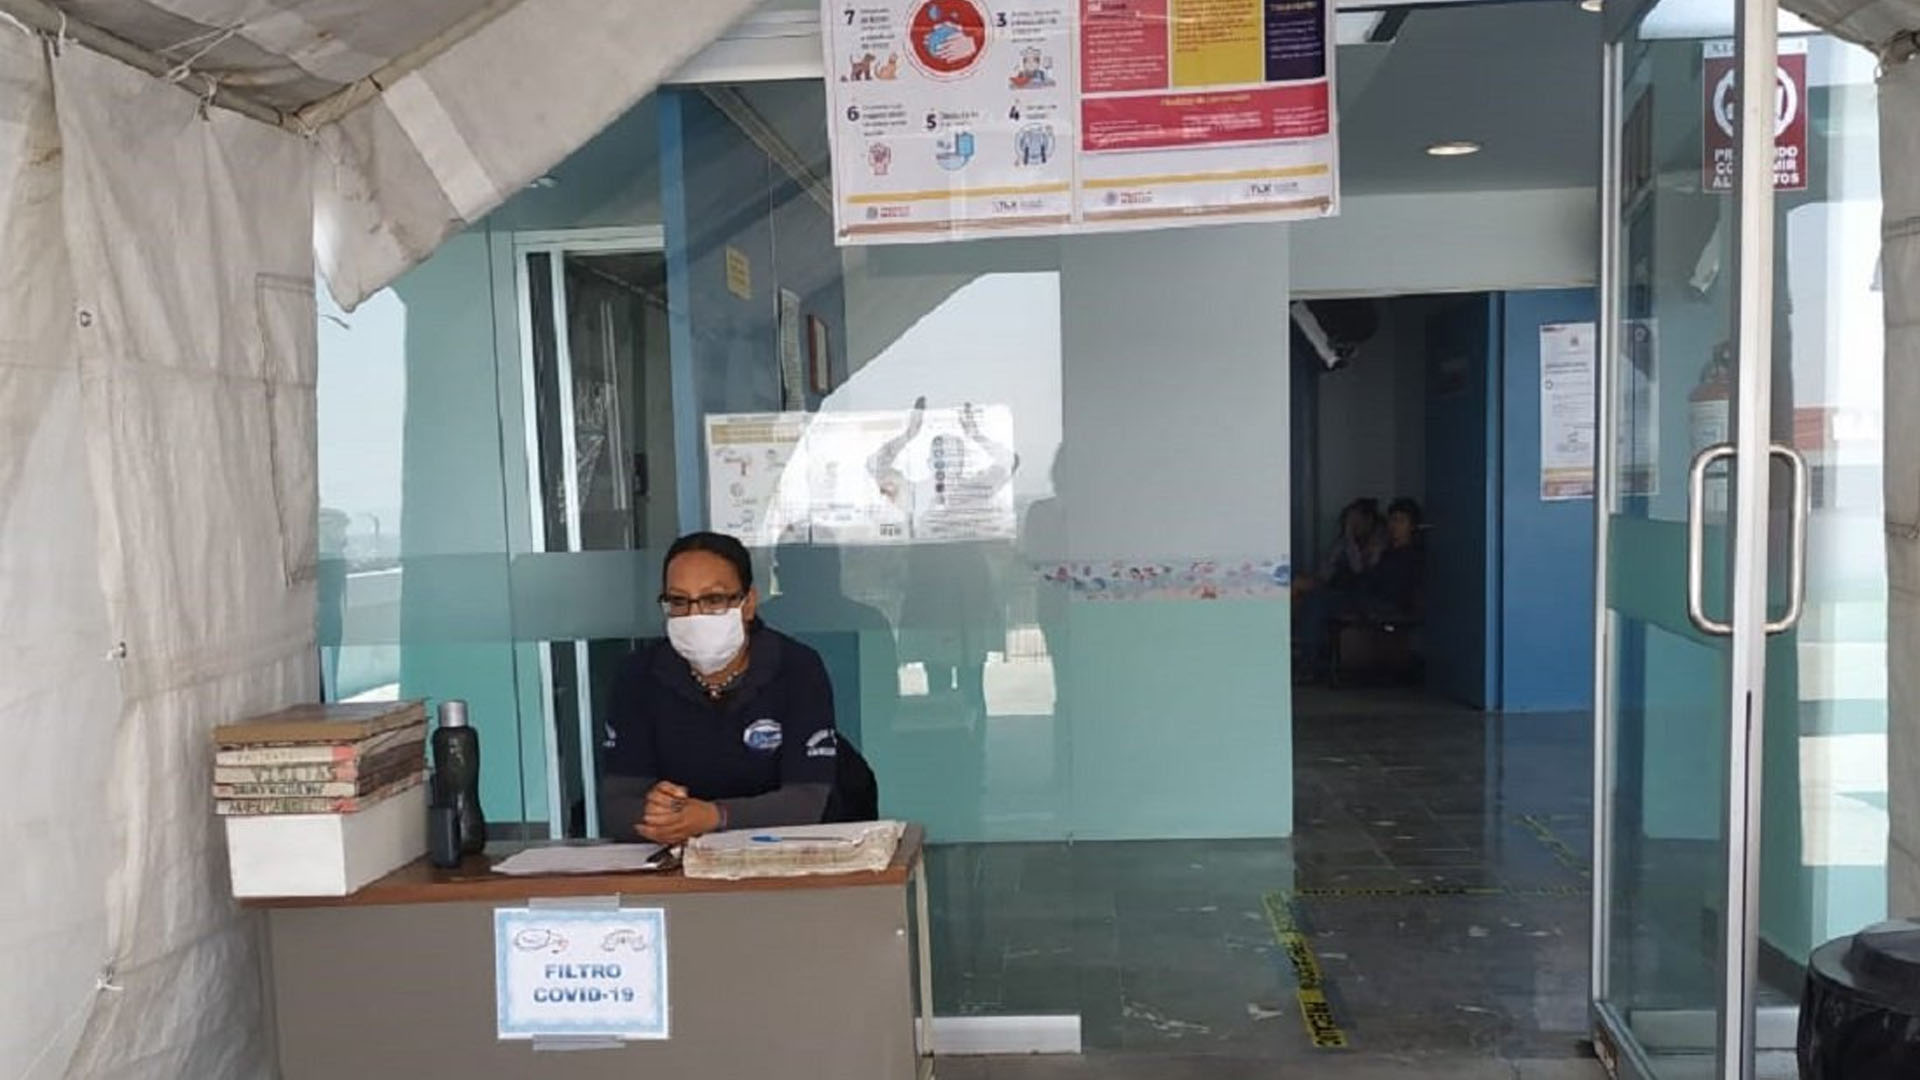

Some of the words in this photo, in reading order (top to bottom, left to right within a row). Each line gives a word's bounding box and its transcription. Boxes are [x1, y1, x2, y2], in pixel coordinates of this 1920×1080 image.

[843, 10, 856, 25] 7
[996, 12, 1007, 27] 3
[847, 106, 859, 121] 6
[1009, 107, 1020, 120] 4
[926, 114, 937, 130] 5
[545, 963, 622, 979] FILTRO
[533, 987, 635, 1003] COVID-19
